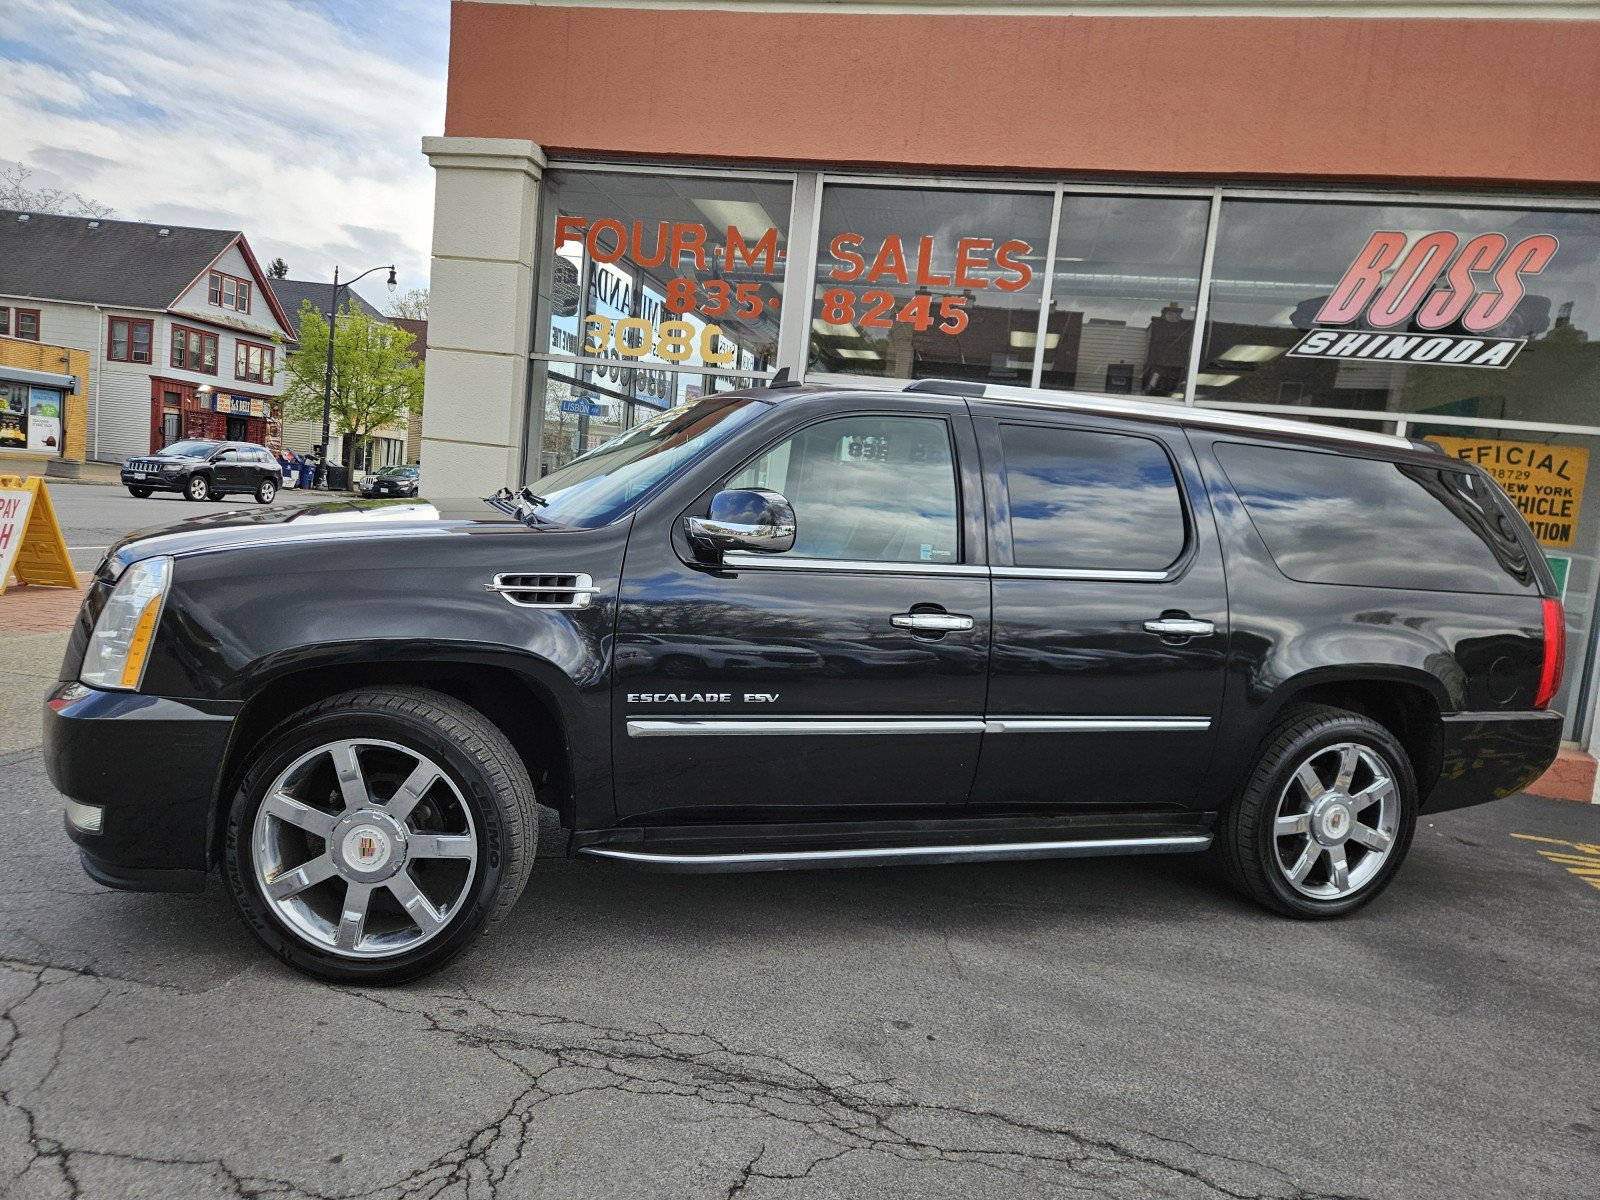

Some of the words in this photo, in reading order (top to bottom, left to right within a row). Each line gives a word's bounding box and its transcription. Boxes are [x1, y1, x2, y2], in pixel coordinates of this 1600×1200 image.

[555, 215, 709, 271] FOUR
[829, 233, 1033, 292] SALES
[1313, 230, 1559, 333] BOSS
[665, 276, 764, 320] 835
[821, 288, 969, 335] 8245
[1298, 332, 1516, 366] SHINODA
[563, 401, 590, 414] LISBON
[1458, 446, 1571, 481] FFICIAL
[1535, 485, 1573, 497] YORK
[1510, 495, 1574, 518] HICLE
[1530, 521, 1571, 542] TION
[627, 693, 732, 703] ESCALADE
[743, 693, 780, 703] ESV
